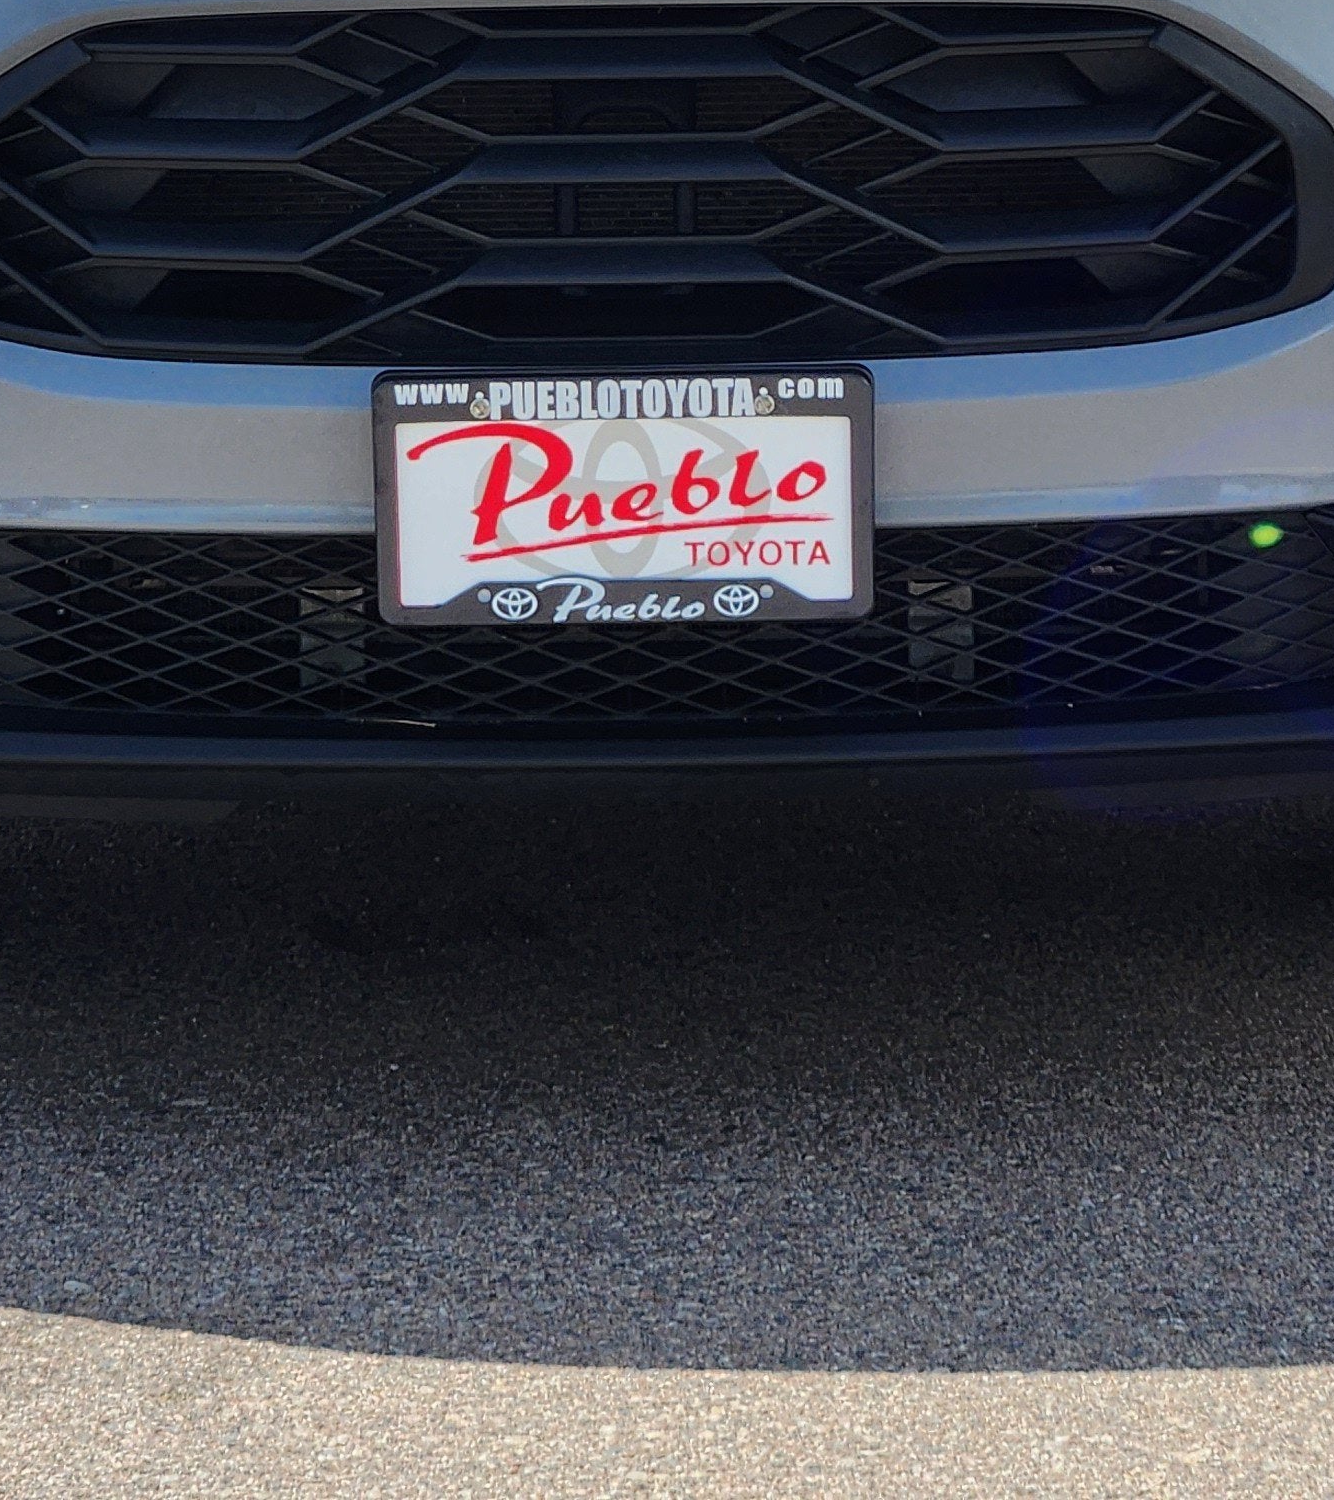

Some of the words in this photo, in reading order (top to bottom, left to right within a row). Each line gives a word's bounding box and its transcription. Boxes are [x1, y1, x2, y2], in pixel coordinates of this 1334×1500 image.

[407, 421, 827, 546] Pueblo
[684, 540, 831, 567] TOYOTA
[536, 577, 705, 623] Pueblo
